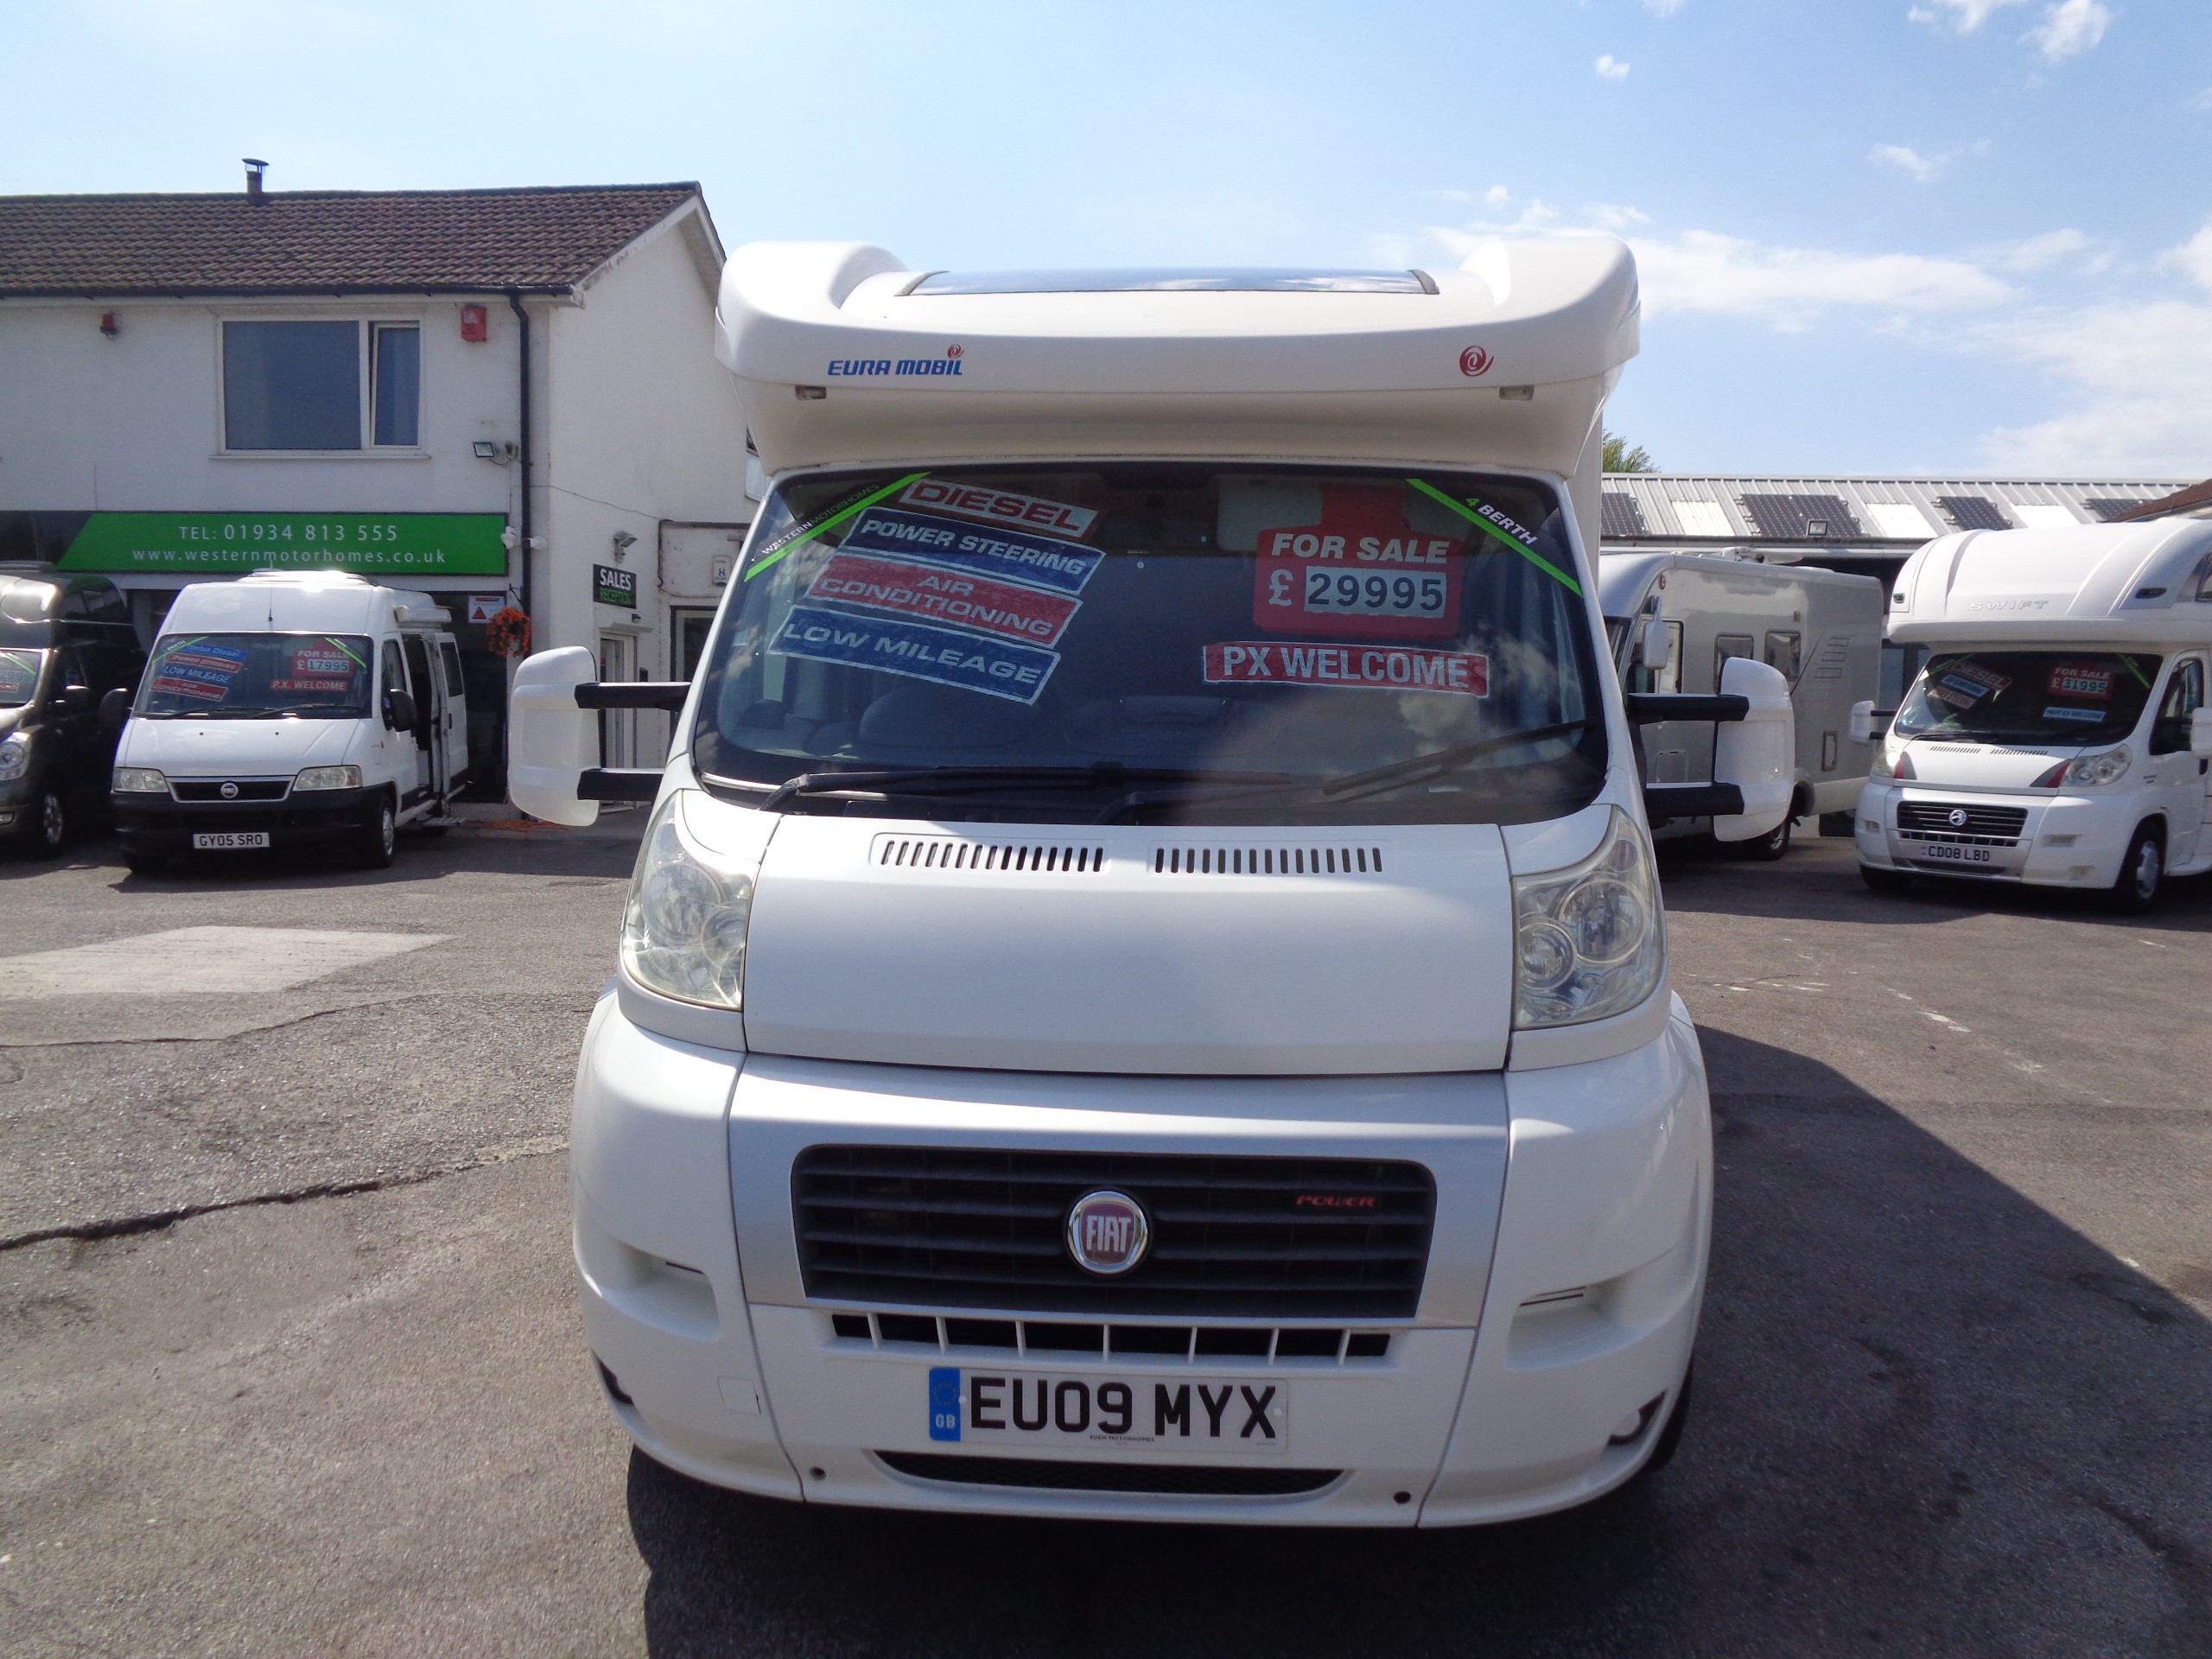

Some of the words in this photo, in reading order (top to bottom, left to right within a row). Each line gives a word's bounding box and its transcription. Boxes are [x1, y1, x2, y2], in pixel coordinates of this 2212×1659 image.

[828, 359, 891, 375] EURA
[895, 359, 963, 376] MOBIL
[908, 482, 1083, 532] DIESEL
[179, 526, 216, 540] TEL:
[223, 524, 293, 541] 01934
[305, 524, 345, 541] 813
[358, 525, 397, 541] 555
[1478, 504, 1538, 544] BERTH
[132, 548, 446, 563] www.westernmotorhomes.co.uk
[861, 518, 951, 548] POWER
[958, 535, 1086, 575] STEERING
[1272, 533, 1346, 560] FOR
[1357, 537, 1450, 564] SALE
[600, 568, 632, 591] SALES
[916, 575, 975, 597] AIR
[1308, 572, 1444, 611] 29995
[819, 577, 1053, 637] CONDITIONING
[1970, 601, 2049, 610] SWIFT
[782, 623, 870, 649] LOW
[873, 638, 1042, 684] MILEAGE
[163, 665, 188, 675] LOW
[188, 669, 231, 683] MILEAGE
[308, 660, 347, 671] 17995
[1224, 646, 1272, 677] PX
[1281, 647, 1469, 689] WELCOME
[2055, 668, 2077, 677] FOR
[2081, 670, 2111, 679] SALE
[295, 681, 346, 690] WELCOME
[2063, 678, 2107, 693] 31995
[200, 835, 233, 847] GY05
[1929, 845, 1961, 859] CD08
[1964, 849, 1990, 861] LBD
[1297, 1194, 1376, 1208] POWER
[1085, 1215, 1132, 1252] FIAT
[970, 1376, 1133, 1434] EU09
[1154, 1383, 1276, 1439] MYX
[935, 1414, 956, 1429] GB
